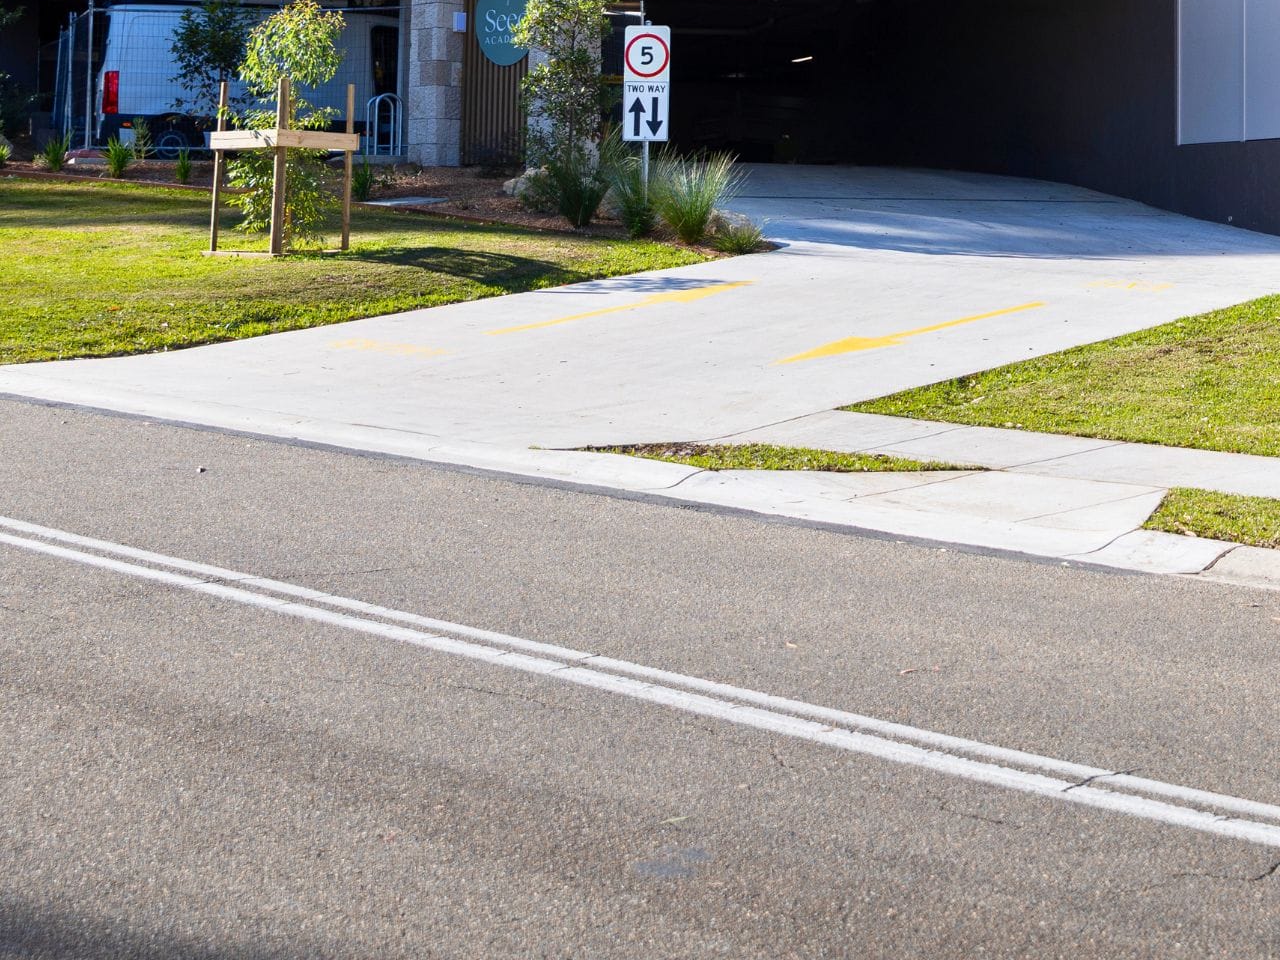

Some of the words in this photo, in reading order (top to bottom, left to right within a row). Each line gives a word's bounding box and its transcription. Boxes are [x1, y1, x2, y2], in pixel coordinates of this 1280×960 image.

[484, 34, 514, 45] ACAD
[640, 46, 654, 66] 5
[627, 84, 645, 93] TWO
[647, 84, 666, 93] WAY
